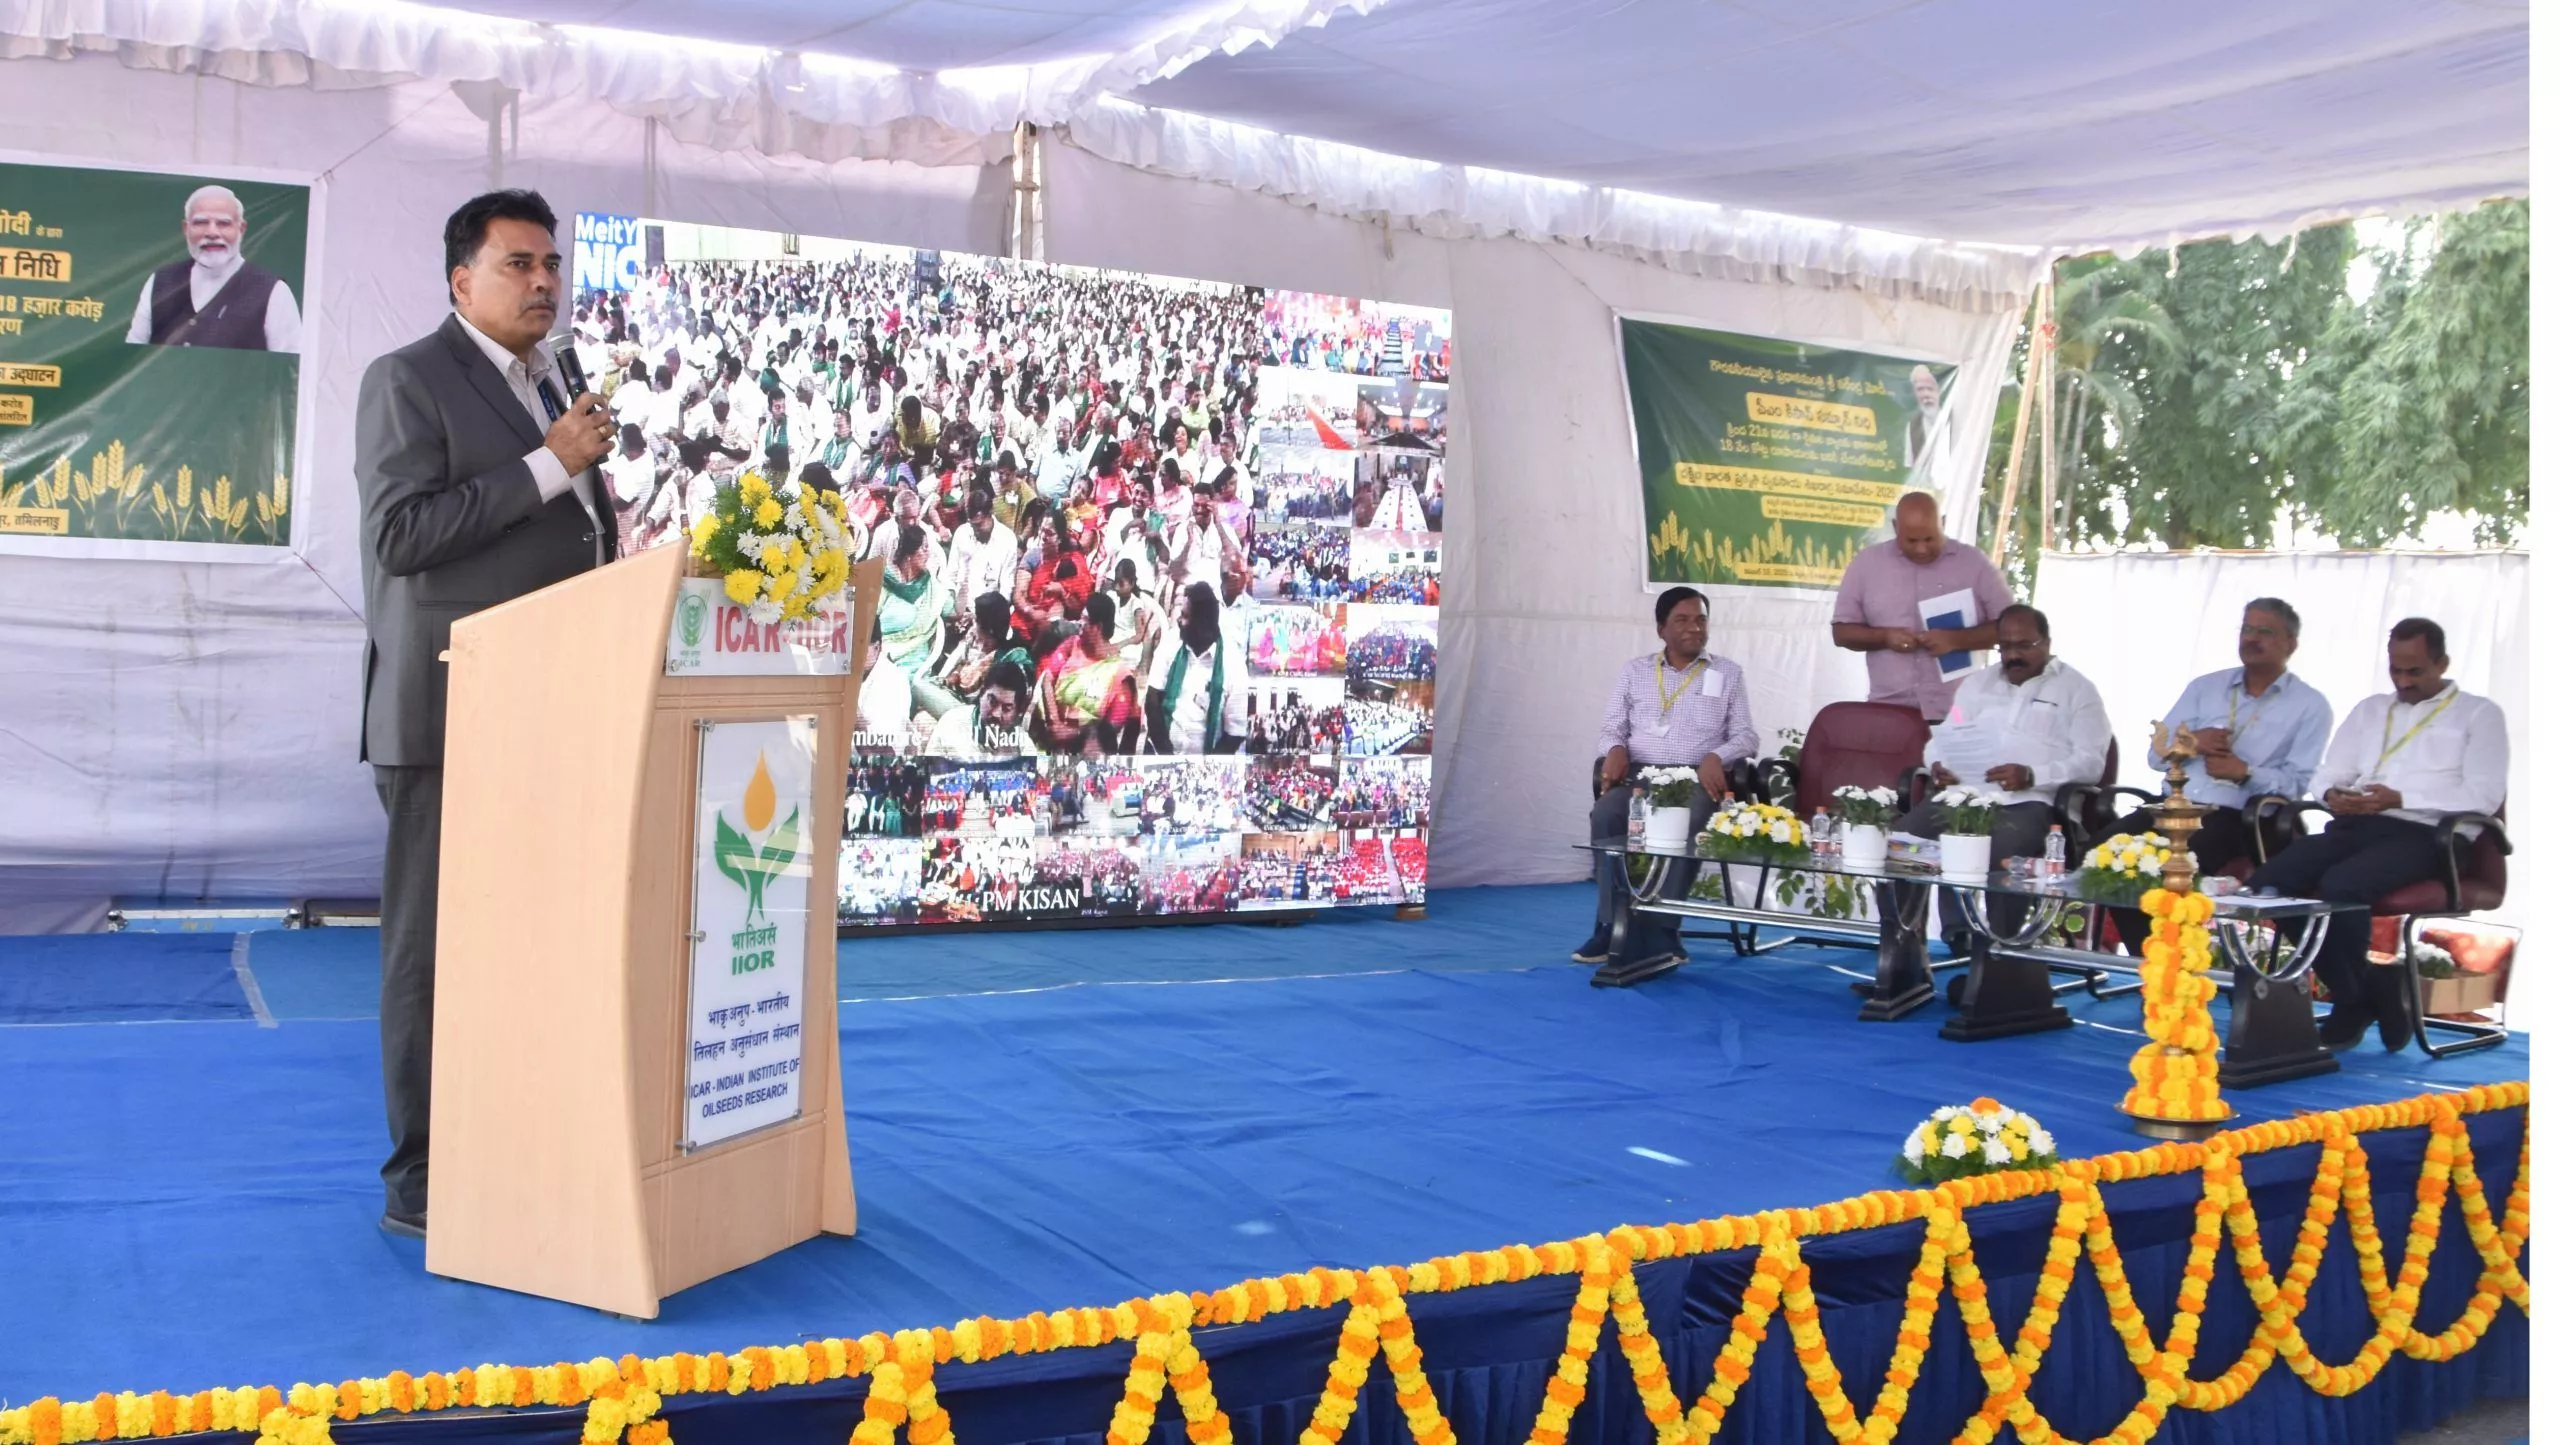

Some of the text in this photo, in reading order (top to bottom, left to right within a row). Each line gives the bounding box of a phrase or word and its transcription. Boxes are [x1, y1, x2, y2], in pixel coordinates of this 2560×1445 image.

[575, 214, 638, 245] MeitY
[14, 250, 61, 279] निधि
[22, 296, 62, 318] हज़ार
[65, 296, 104, 322] करोड़
[14, 512, 60, 531] तमिलनाडु
[982, 888, 1080, 912] PM KISAN
[732, 950, 775, 976] IIOR
[757, 992, 790, 1015] भारतीय
[694, 1023, 800, 1062] तिलहन अनुसंधान संस्थान
[717, 1072, 745, 1092] INDIAN
[748, 1061, 788, 1084] INSTITUTE
[789, 1057, 800, 1072] OF
[702, 1082, 788, 1118] OILSEEDS RESEARCH
